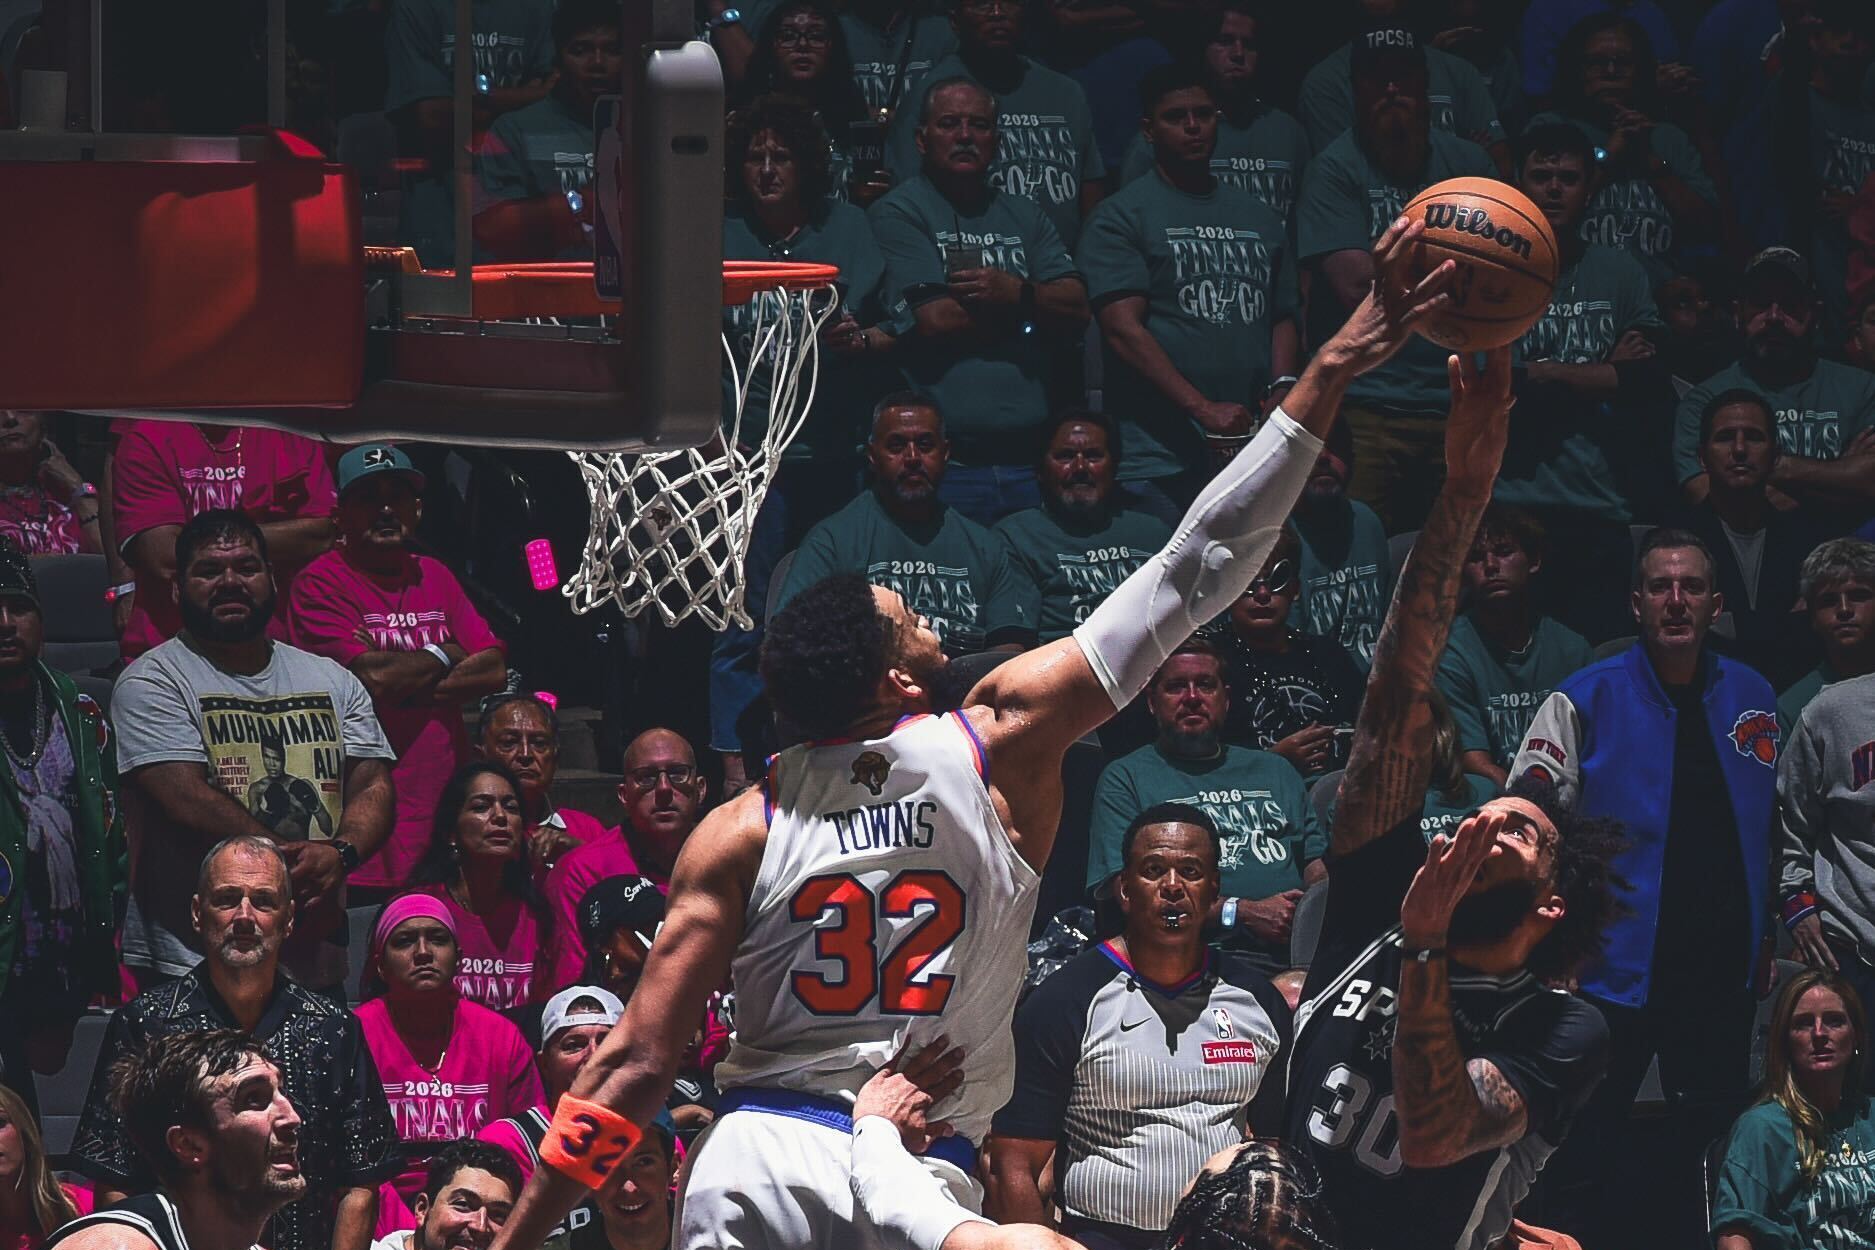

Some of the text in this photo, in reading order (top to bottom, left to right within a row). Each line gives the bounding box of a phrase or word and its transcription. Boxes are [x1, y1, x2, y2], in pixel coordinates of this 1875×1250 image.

[1365, 30, 1416, 49] TPCSA
[1001, 114, 1040, 128] 2026
[1044, 164, 1077, 206] GO
[1194, 225, 1236, 241] 2026
[1424, 203, 1532, 262] Wilson
[1166, 240, 1271, 288] FINALS
[1176, 280, 1218, 320] GO
[891, 560, 937, 576] 2026
[1086, 547, 1130, 563] 2026
[206, 712, 337, 746] MUHAMMAD
[1198, 791, 1242, 805] 2026
[823, 800, 938, 858] TOWNS
[1203, 803, 1289, 837] NALS
[788, 868, 968, 1018] 32
[461, 957, 505, 974] 2026
[1203, 1046, 1255, 1061] Emirates
[404, 1080, 454, 1098] 2026
[387, 1099, 489, 1141] INALS
[560, 1112, 631, 1176] 32
